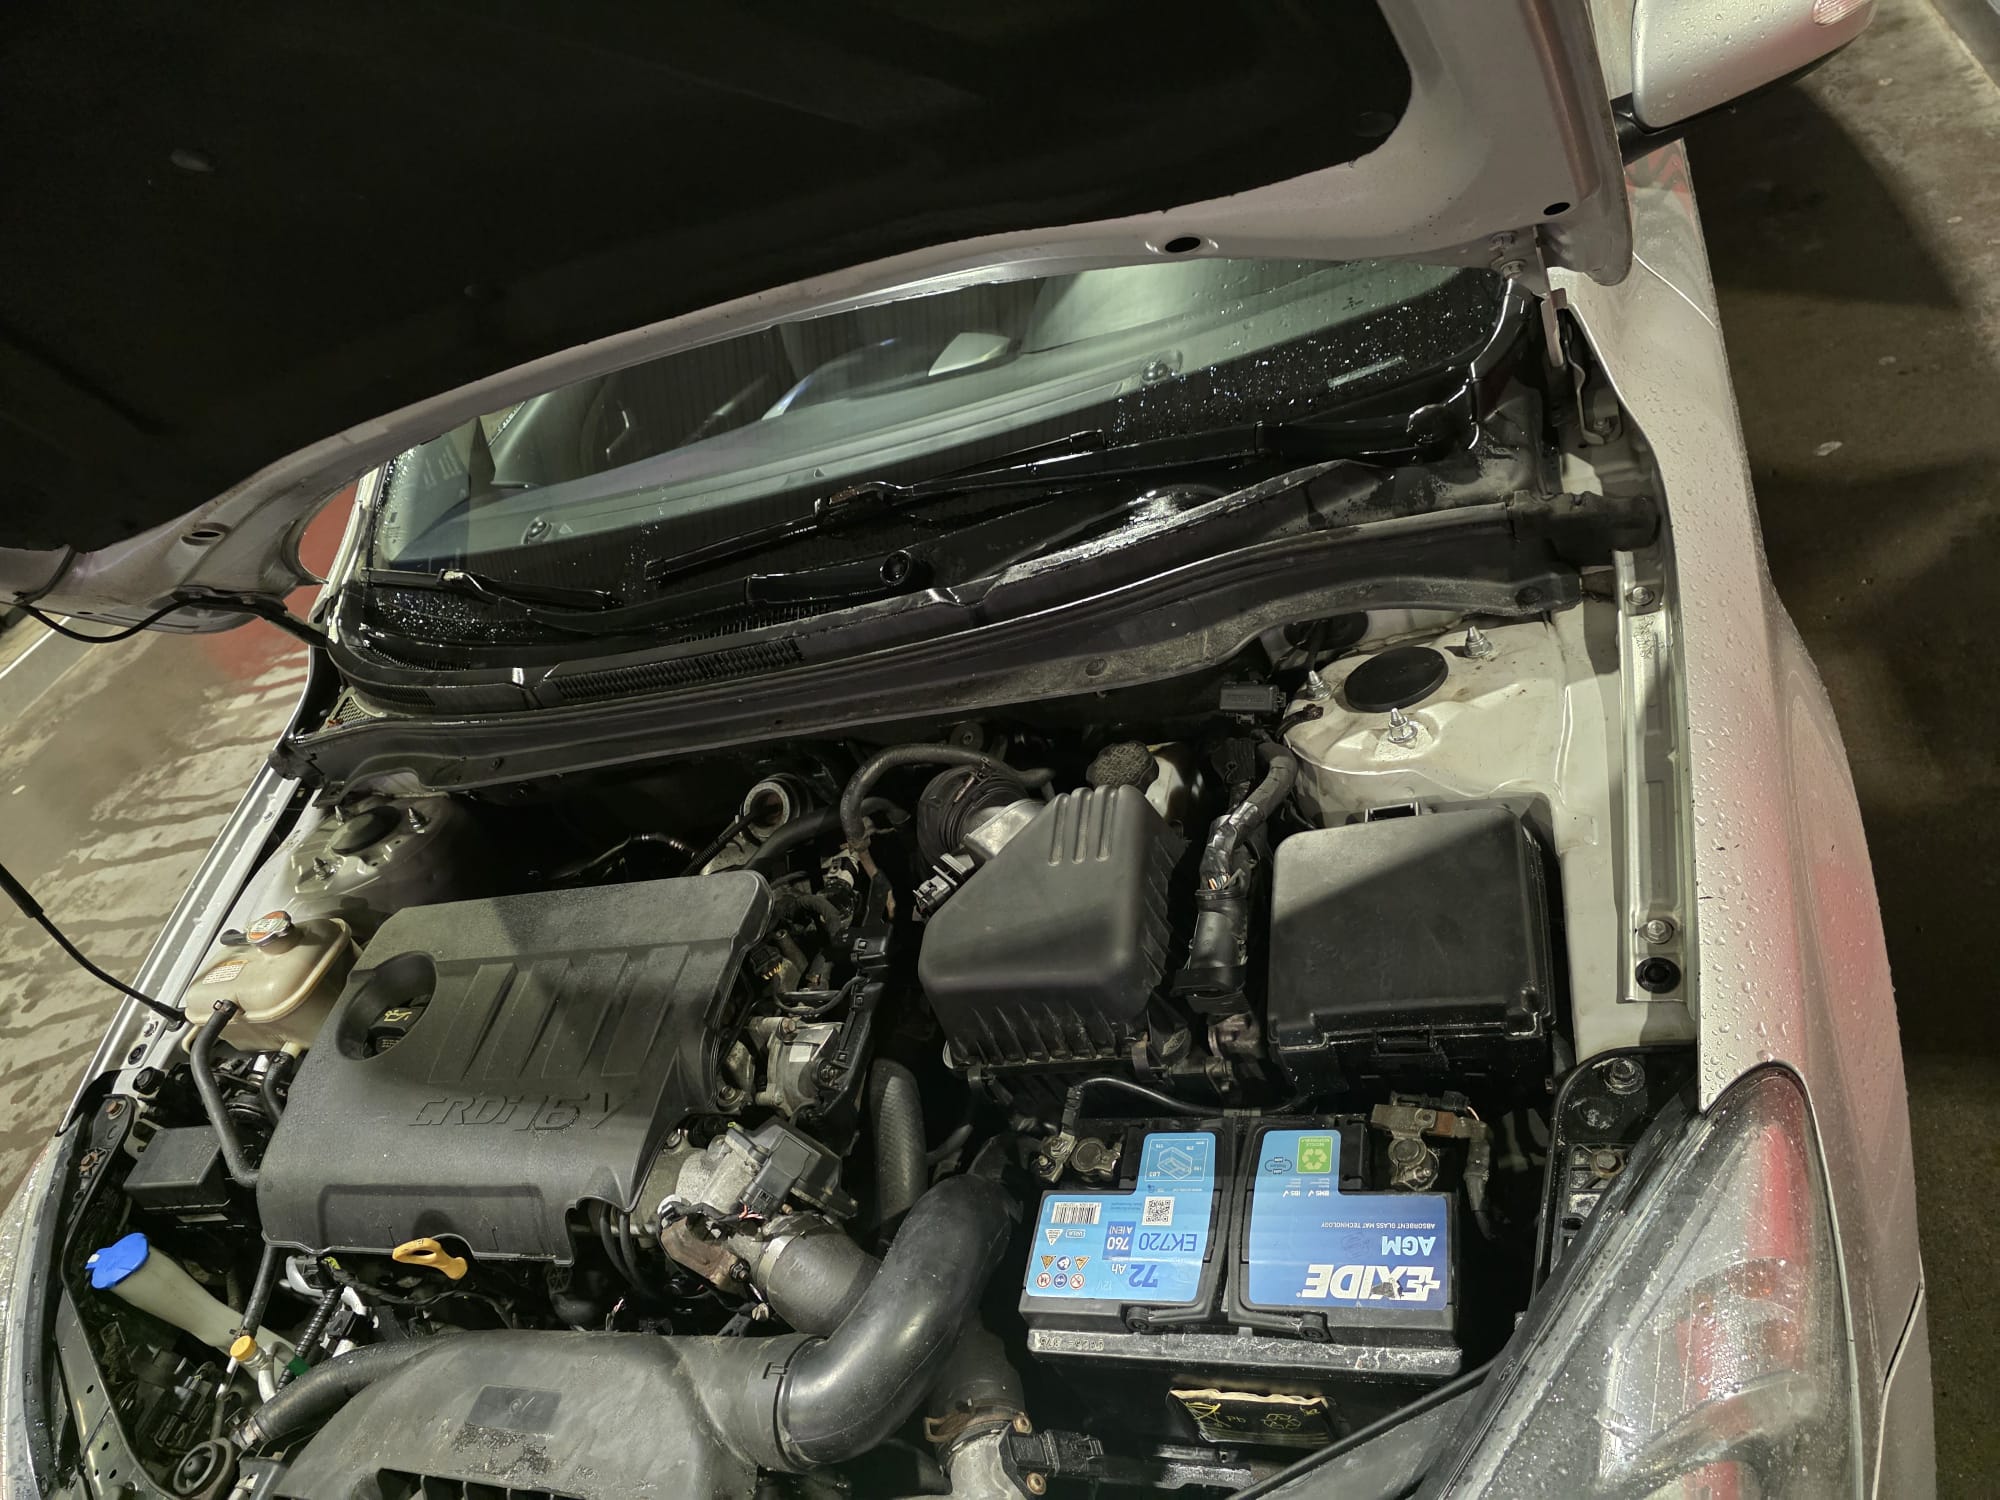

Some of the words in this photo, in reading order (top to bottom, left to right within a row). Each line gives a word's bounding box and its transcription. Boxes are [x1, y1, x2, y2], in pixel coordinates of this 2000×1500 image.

[1320, 1221, 1361, 1229] TECHNOLOGY
[1396, 1222, 1436, 1230] ABSORBENT
[1107, 1236, 1130, 1250] 760
[1138, 1232, 1198, 1251] EK720
[1381, 1236, 1437, 1256] AGM
[1111, 1263, 1127, 1275] Ah
[1128, 1264, 1159, 1288] 72
[1300, 1263, 1441, 1301] EXIDE
